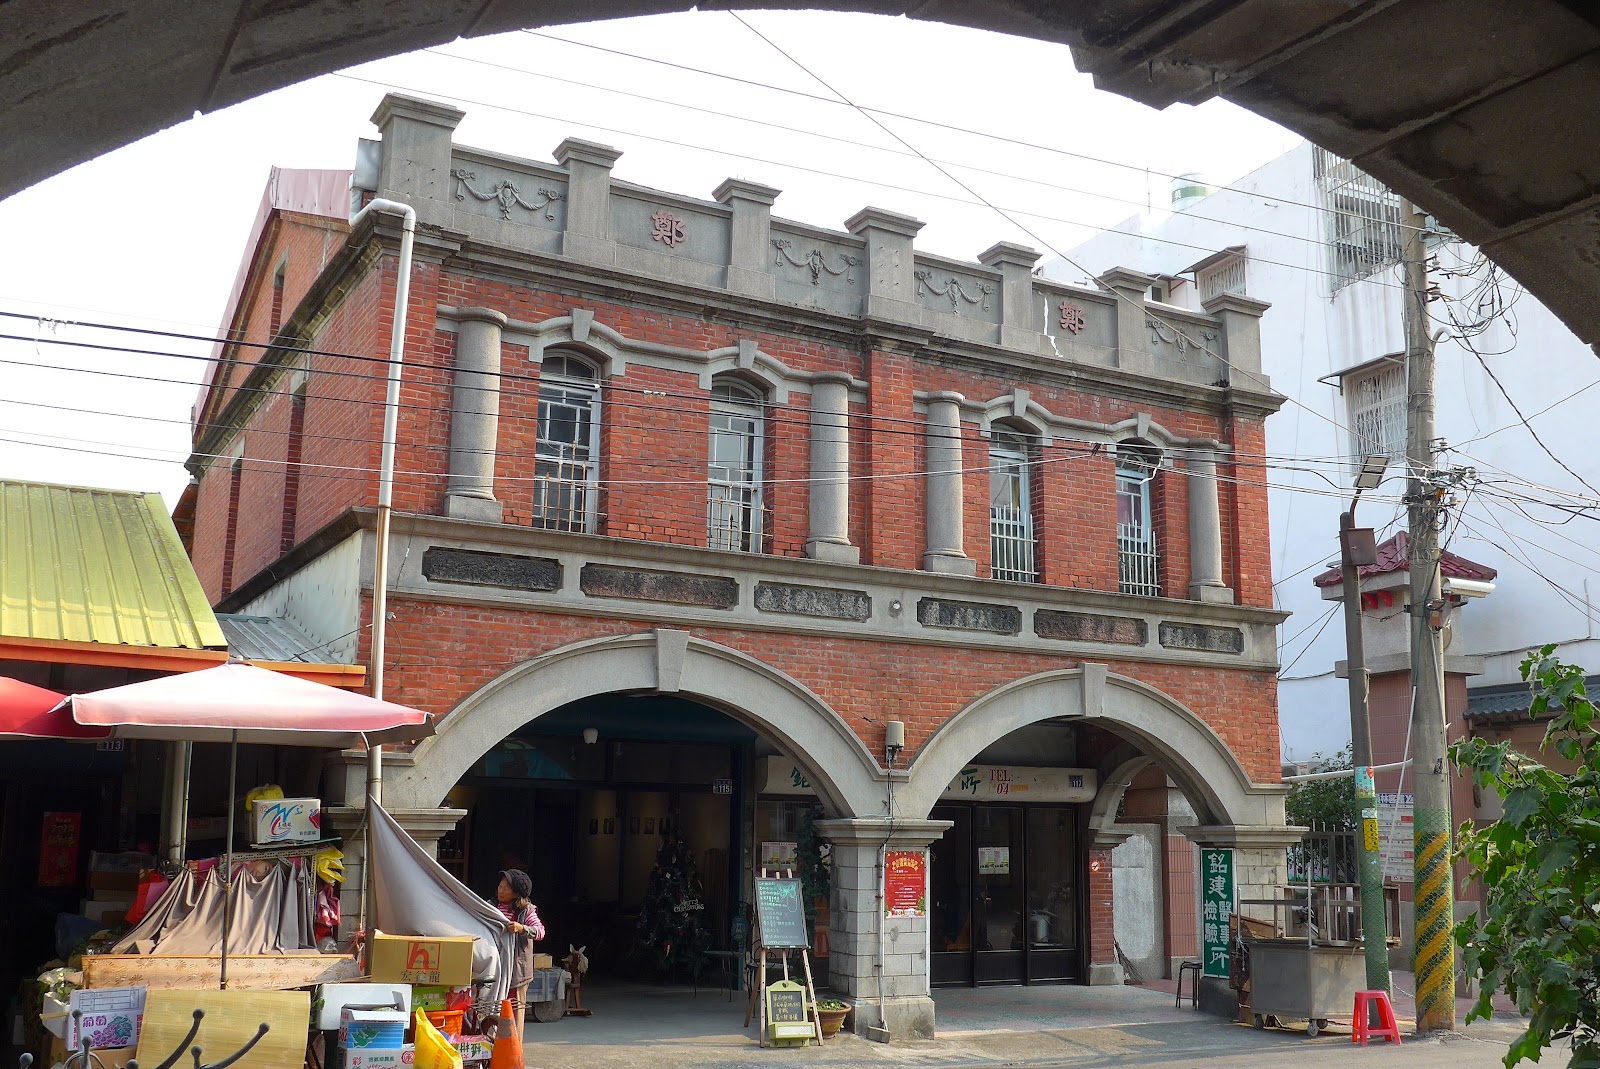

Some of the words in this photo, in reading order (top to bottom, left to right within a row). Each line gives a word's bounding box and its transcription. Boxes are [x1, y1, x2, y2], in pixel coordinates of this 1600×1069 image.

[651, 210, 687, 248] 鄭
[1059, 300, 1087, 335] 鄭
[105, 741, 121, 749] 113
[989, 769, 1013, 782] TEL:
[718, 785, 730, 793] 115
[996, 783, 1009, 794] 04
[1208, 853, 1227, 899] 銘建
[1204, 900, 1218, 943] 檢驗
[1210, 947, 1229, 969] 所
